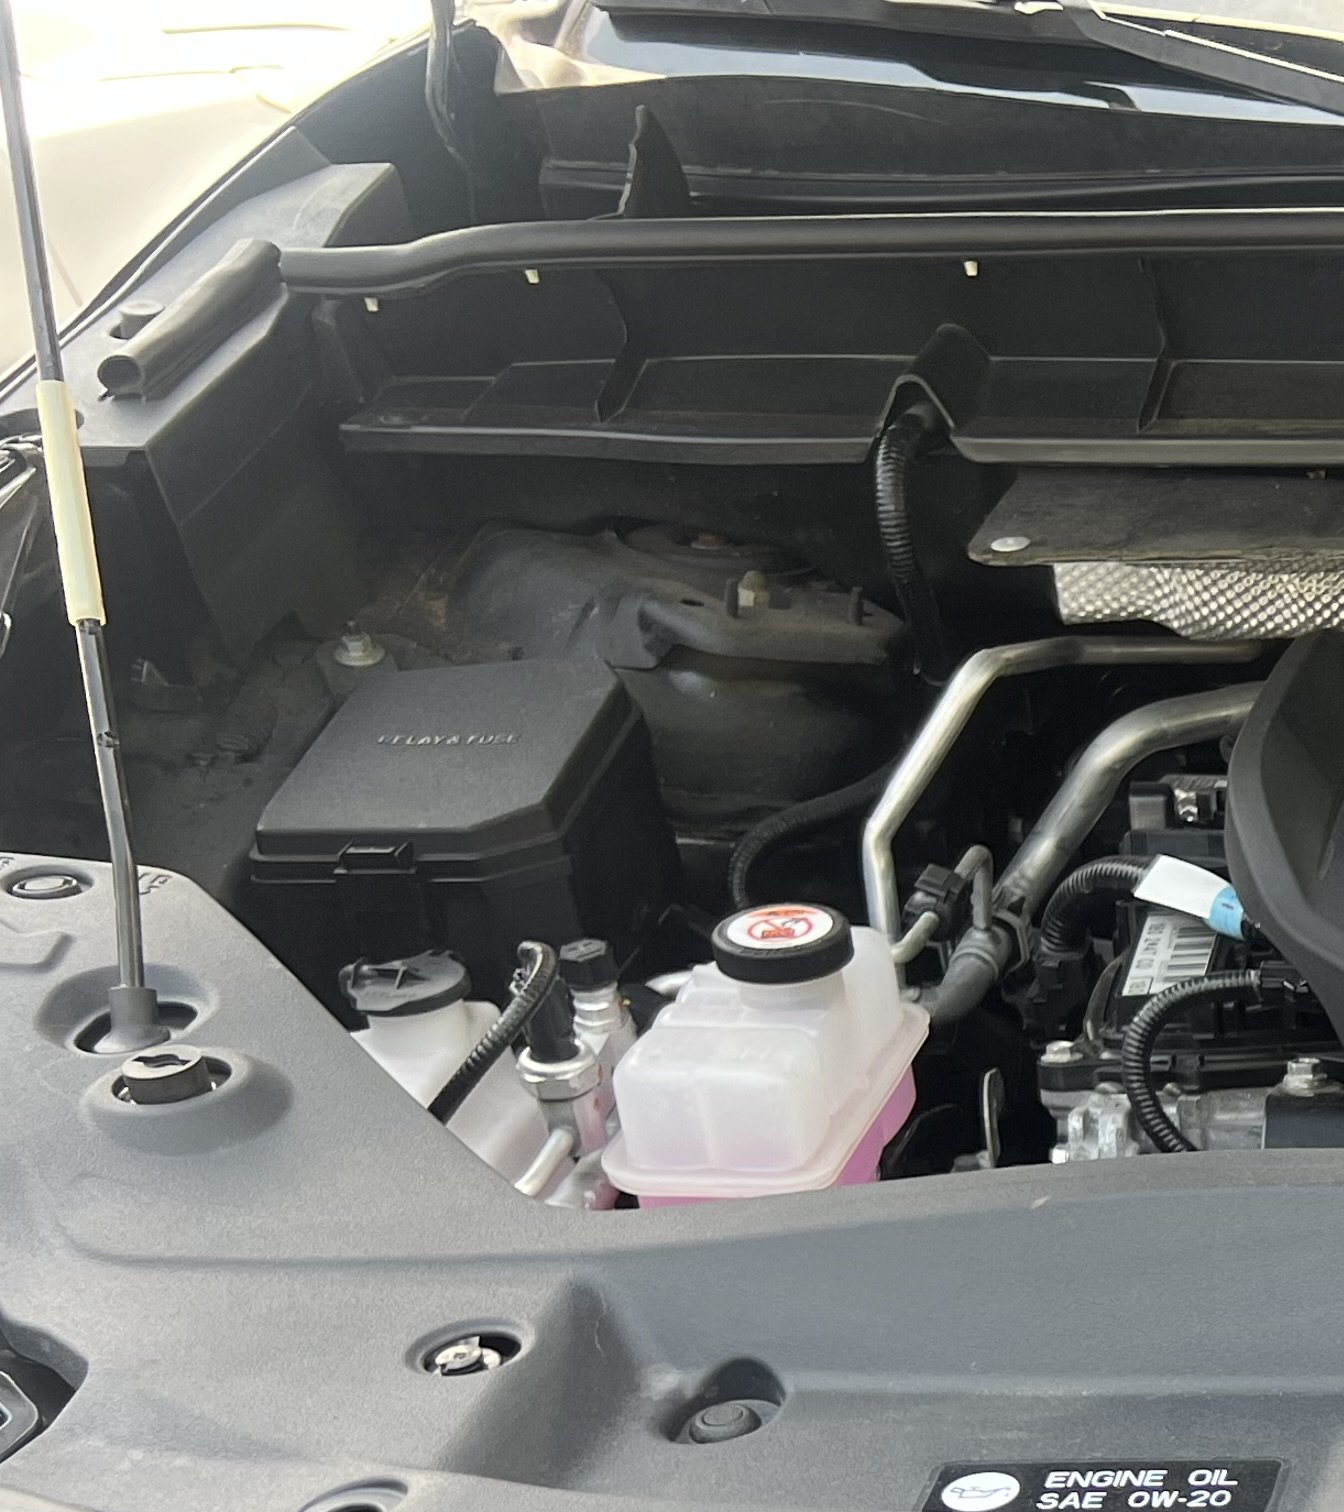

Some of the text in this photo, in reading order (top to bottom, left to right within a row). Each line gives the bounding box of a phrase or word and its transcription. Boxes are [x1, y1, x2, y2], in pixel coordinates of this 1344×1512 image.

[1044, 1469, 1239, 1489] ENGINE OIL
[1036, 1489, 1232, 1510] SAE 0W-20
